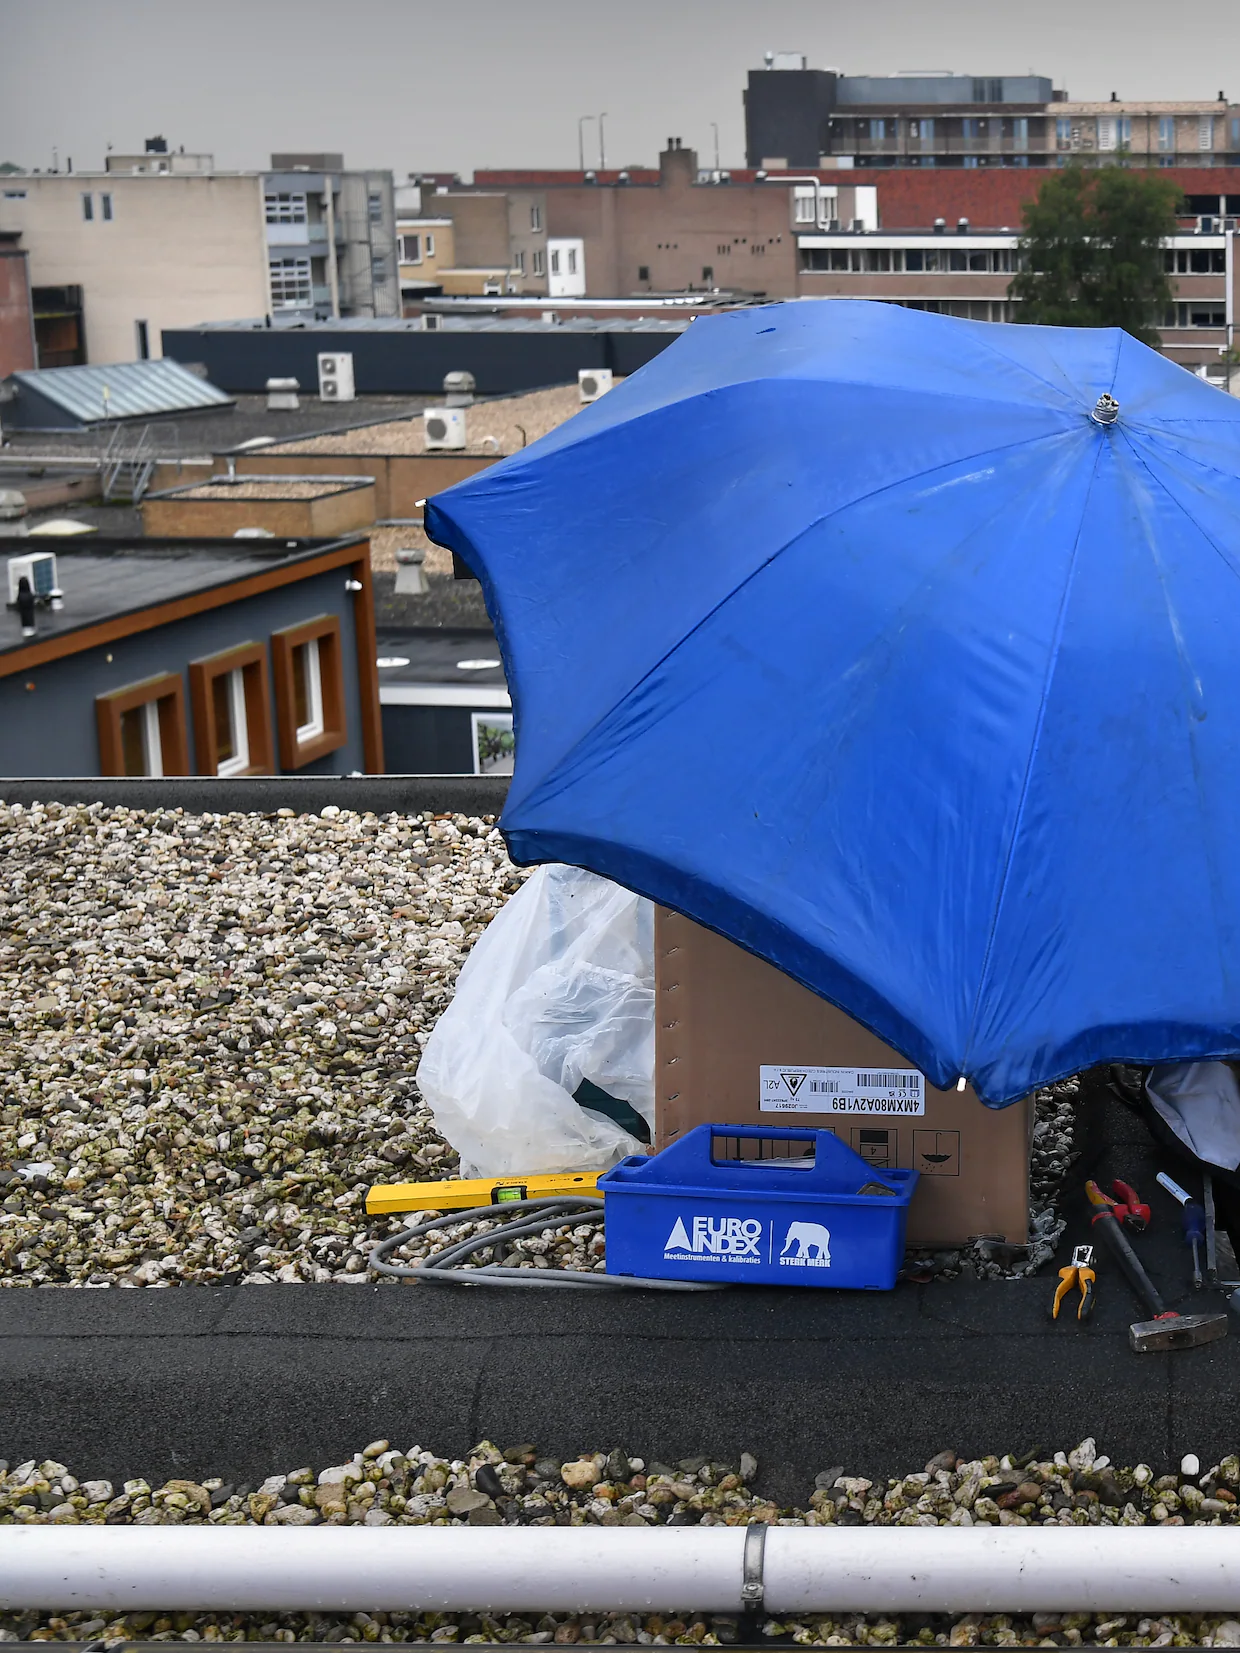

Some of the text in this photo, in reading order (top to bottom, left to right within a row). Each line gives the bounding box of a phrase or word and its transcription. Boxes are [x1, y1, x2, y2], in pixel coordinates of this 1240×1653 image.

[763, 1080, 780, 1089] A2L
[832, 1098, 919, 1112] 4MXM80A2V1B9
[693, 1216, 762, 1238] EURO
[693, 1234, 761, 1255] INDEX
[664, 1252, 721, 1262] Meetinstrumenten
[728, 1255, 761, 1264] kalibraties
[779, 1257, 831, 1268] STERK MERK
